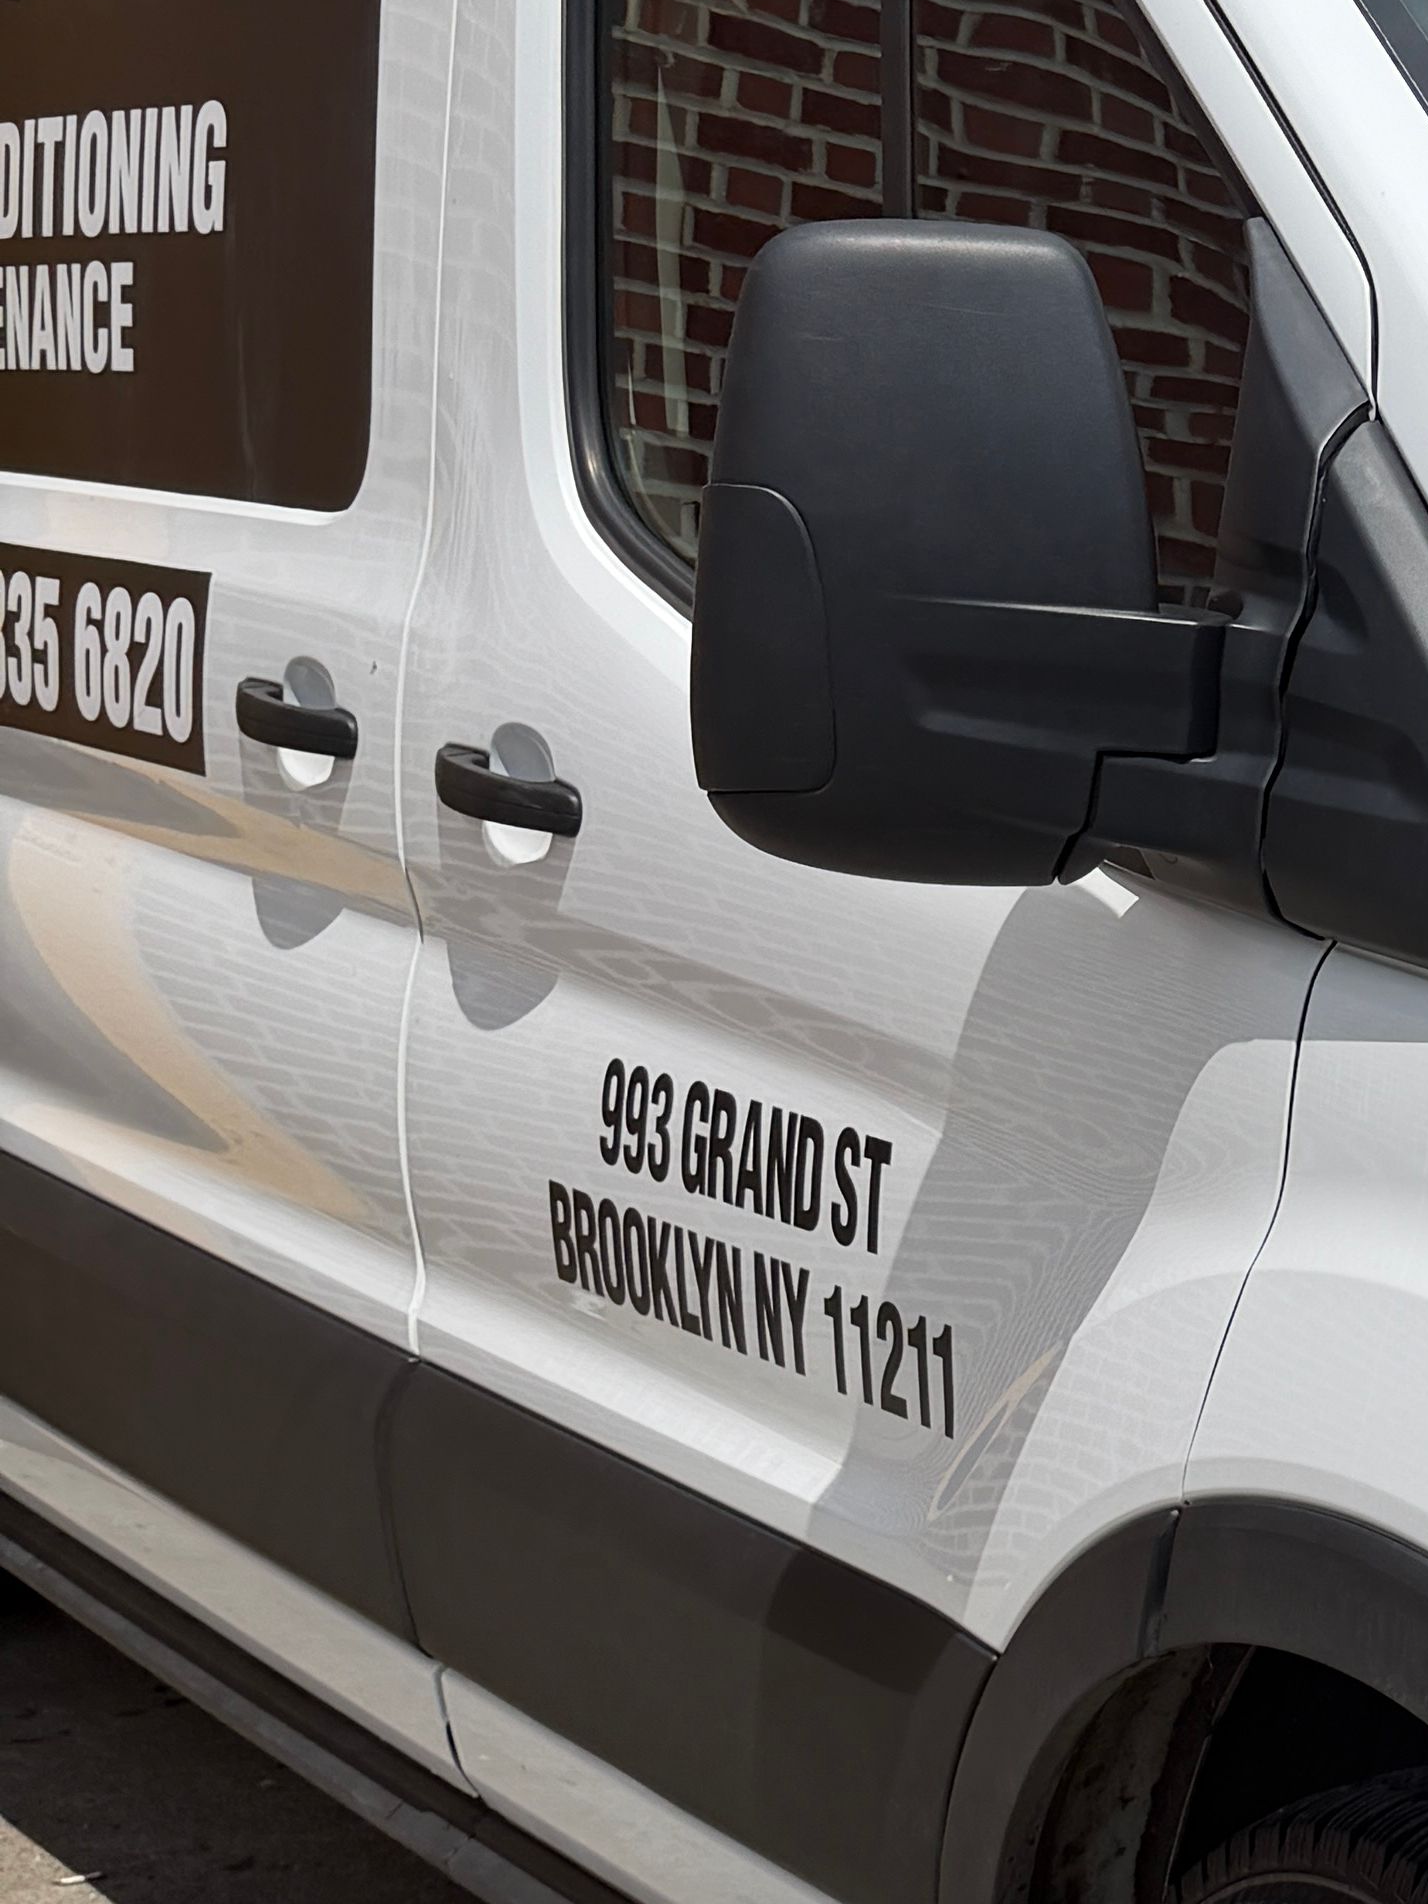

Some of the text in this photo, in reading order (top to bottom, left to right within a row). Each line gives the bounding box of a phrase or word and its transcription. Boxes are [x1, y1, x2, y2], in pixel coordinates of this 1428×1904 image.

[0, 259, 135, 374] NANCE
[0, 569, 196, 744] 35 6820
[599, 1057, 893, 1255] 993 GRAND ST
[548, 1178, 955, 1440] BROOKLYN NY 11211
